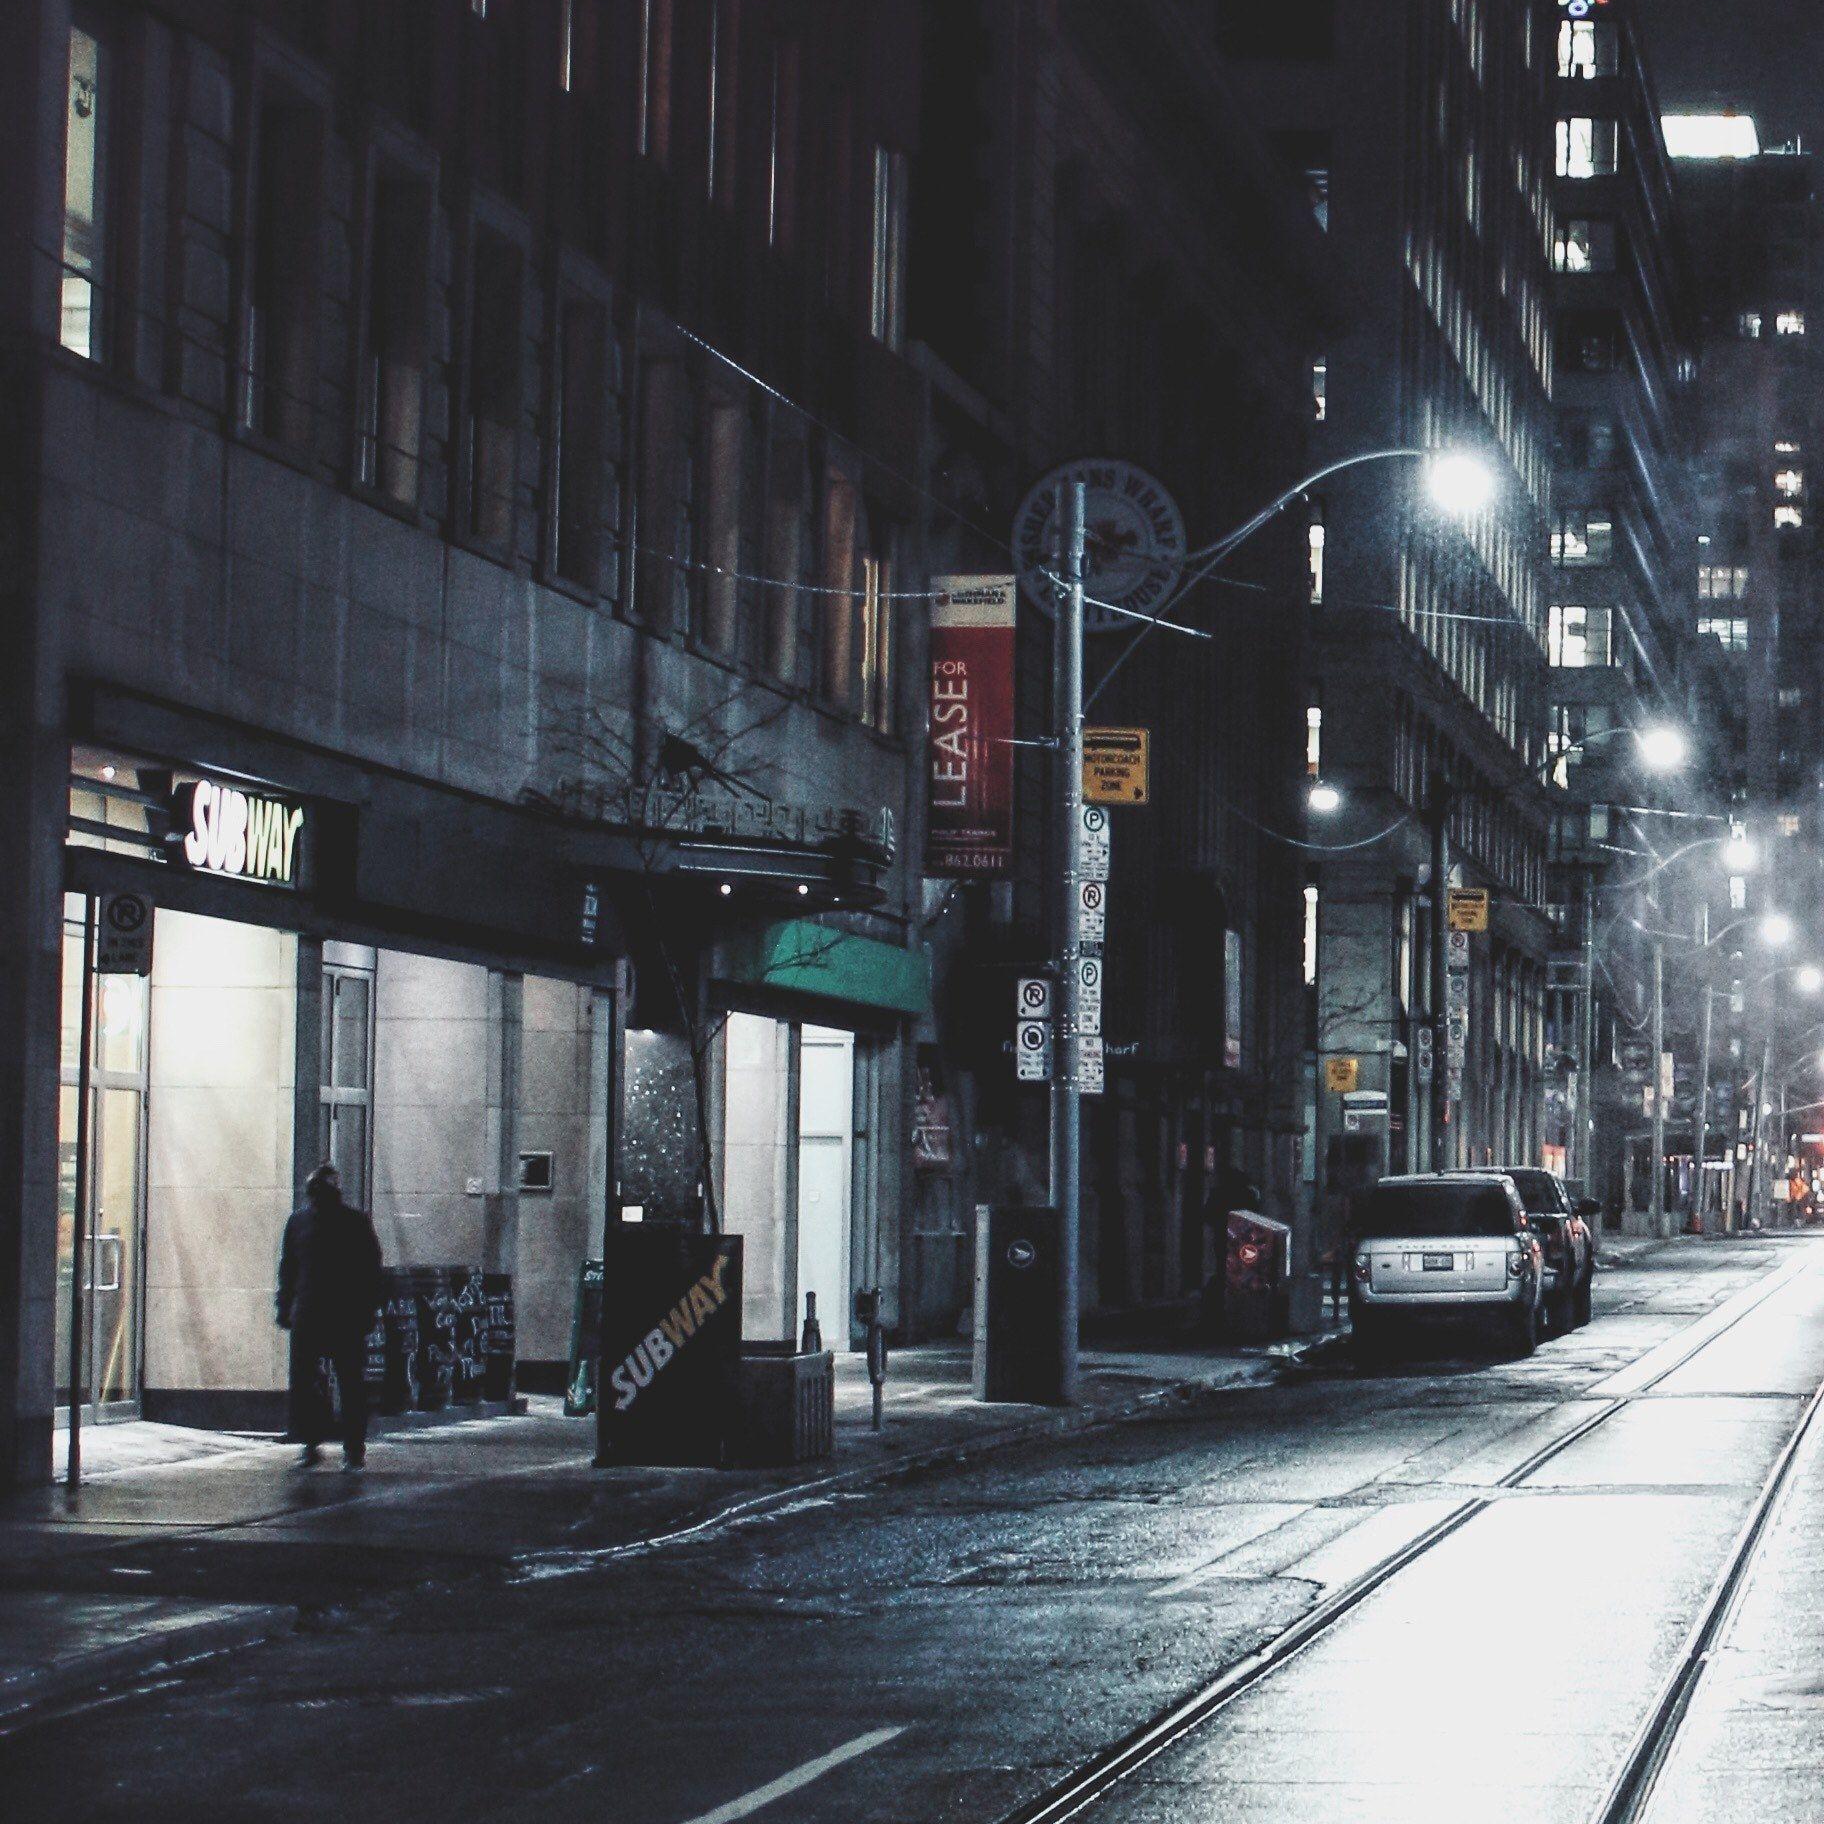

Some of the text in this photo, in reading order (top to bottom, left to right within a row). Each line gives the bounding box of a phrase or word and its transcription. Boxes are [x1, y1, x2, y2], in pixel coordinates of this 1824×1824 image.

[934, 661, 968, 675] FOR
[932, 678, 968, 808] LEASE
[184, 779, 305, 882] SUBWAY
[610, 1254, 730, 1411] SUBWAY
